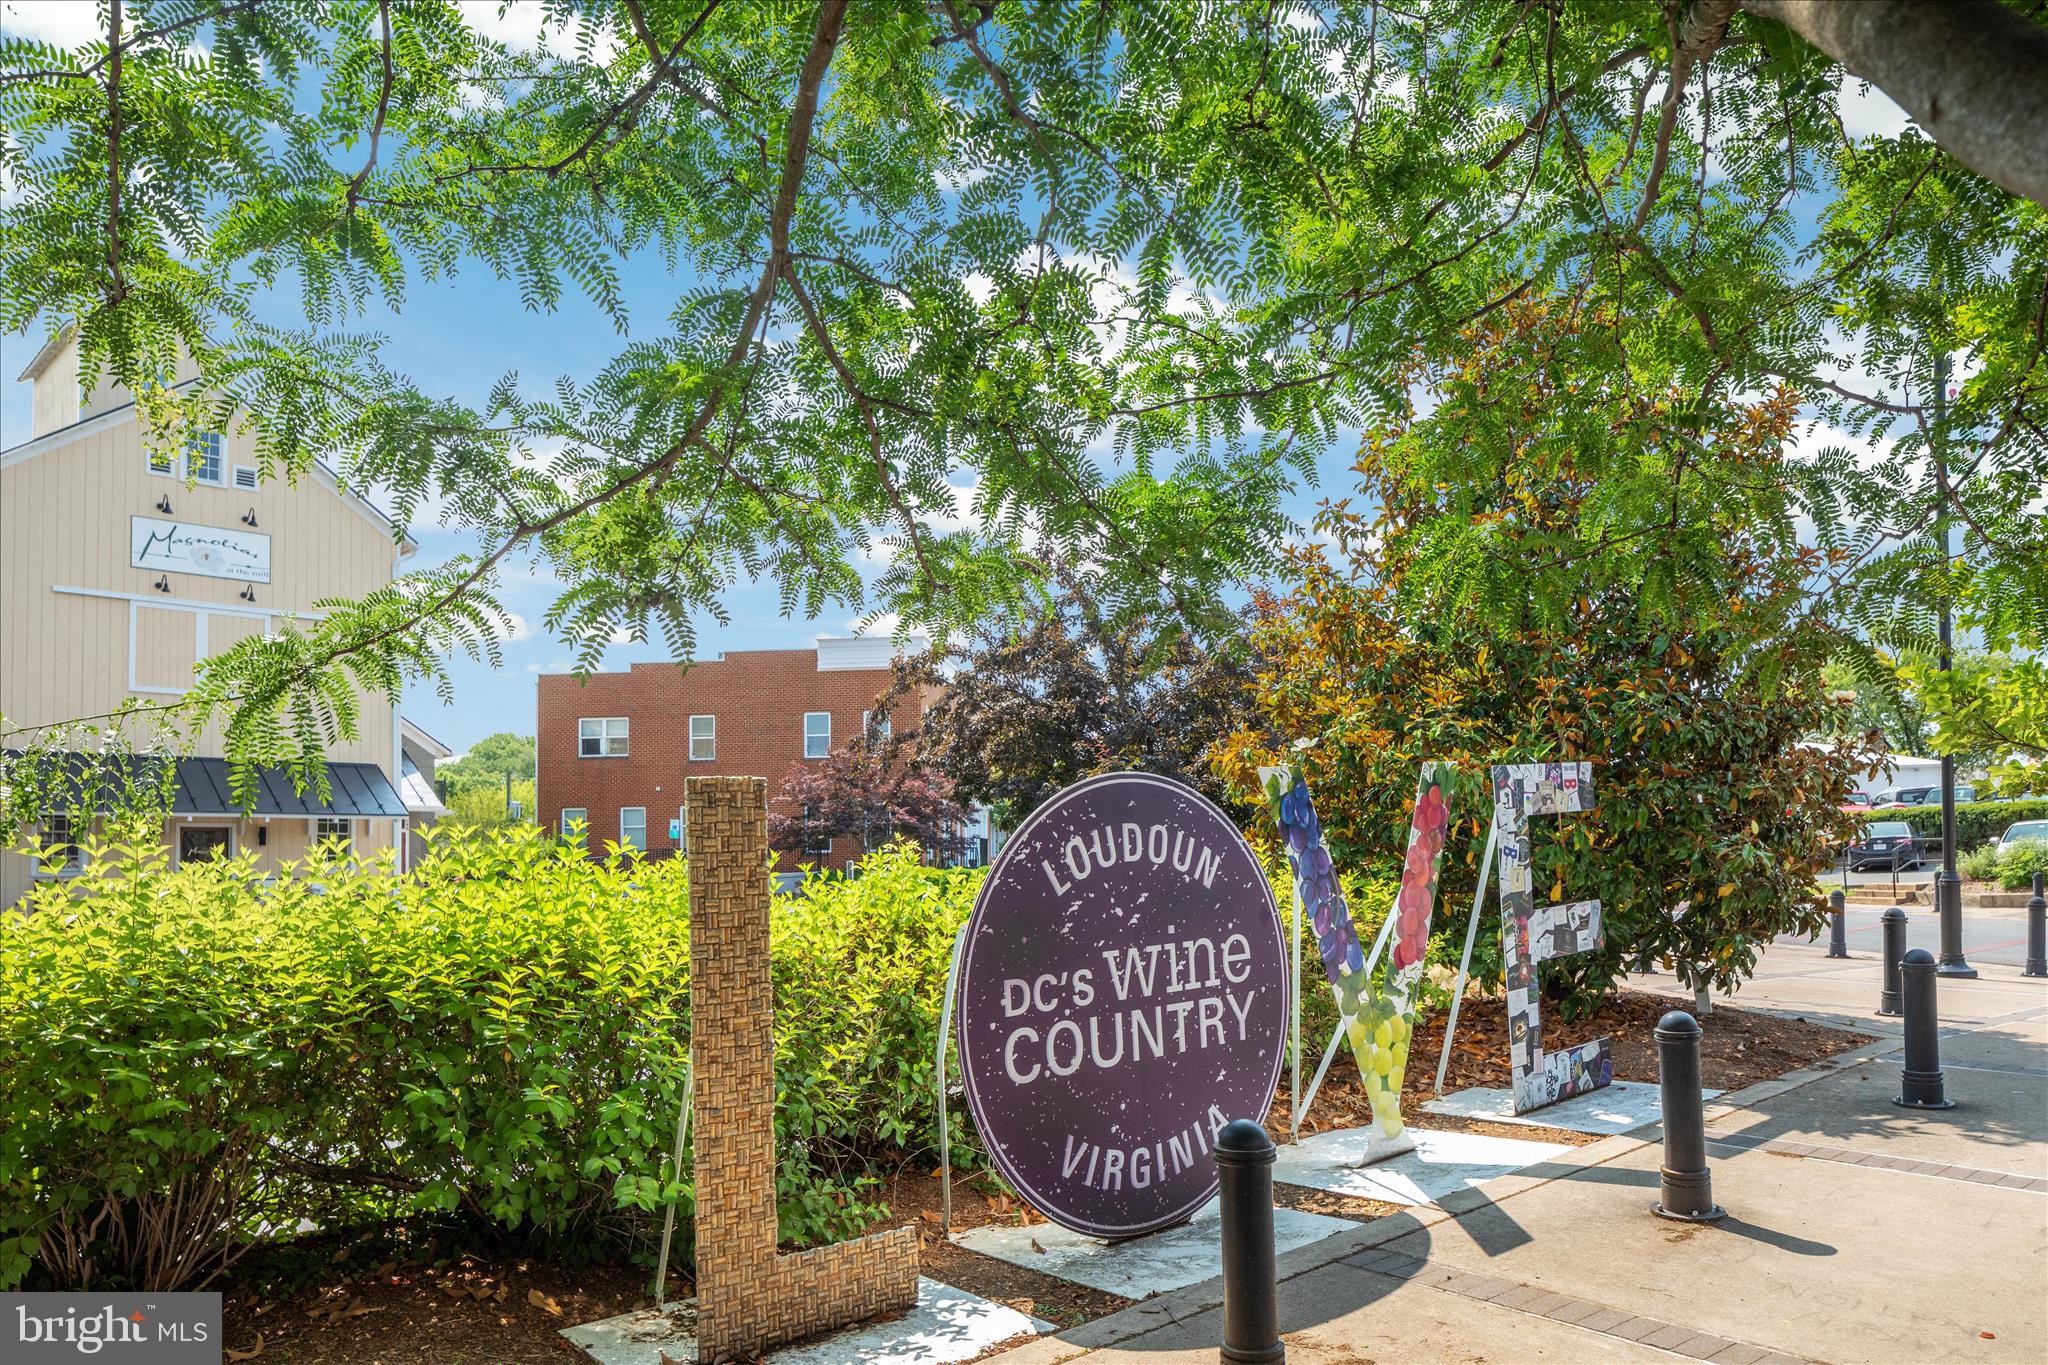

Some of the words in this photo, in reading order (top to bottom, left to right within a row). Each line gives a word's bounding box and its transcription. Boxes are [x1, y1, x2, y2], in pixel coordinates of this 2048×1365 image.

[140, 525, 258, 561] Magnolias
[1042, 822, 1222, 897] LOUDOUN
[1102, 925, 1252, 1001] Wine
[1004, 990, 1255, 1085] COUNTRY
[1061, 1104, 1230, 1191] VIRGINIA
